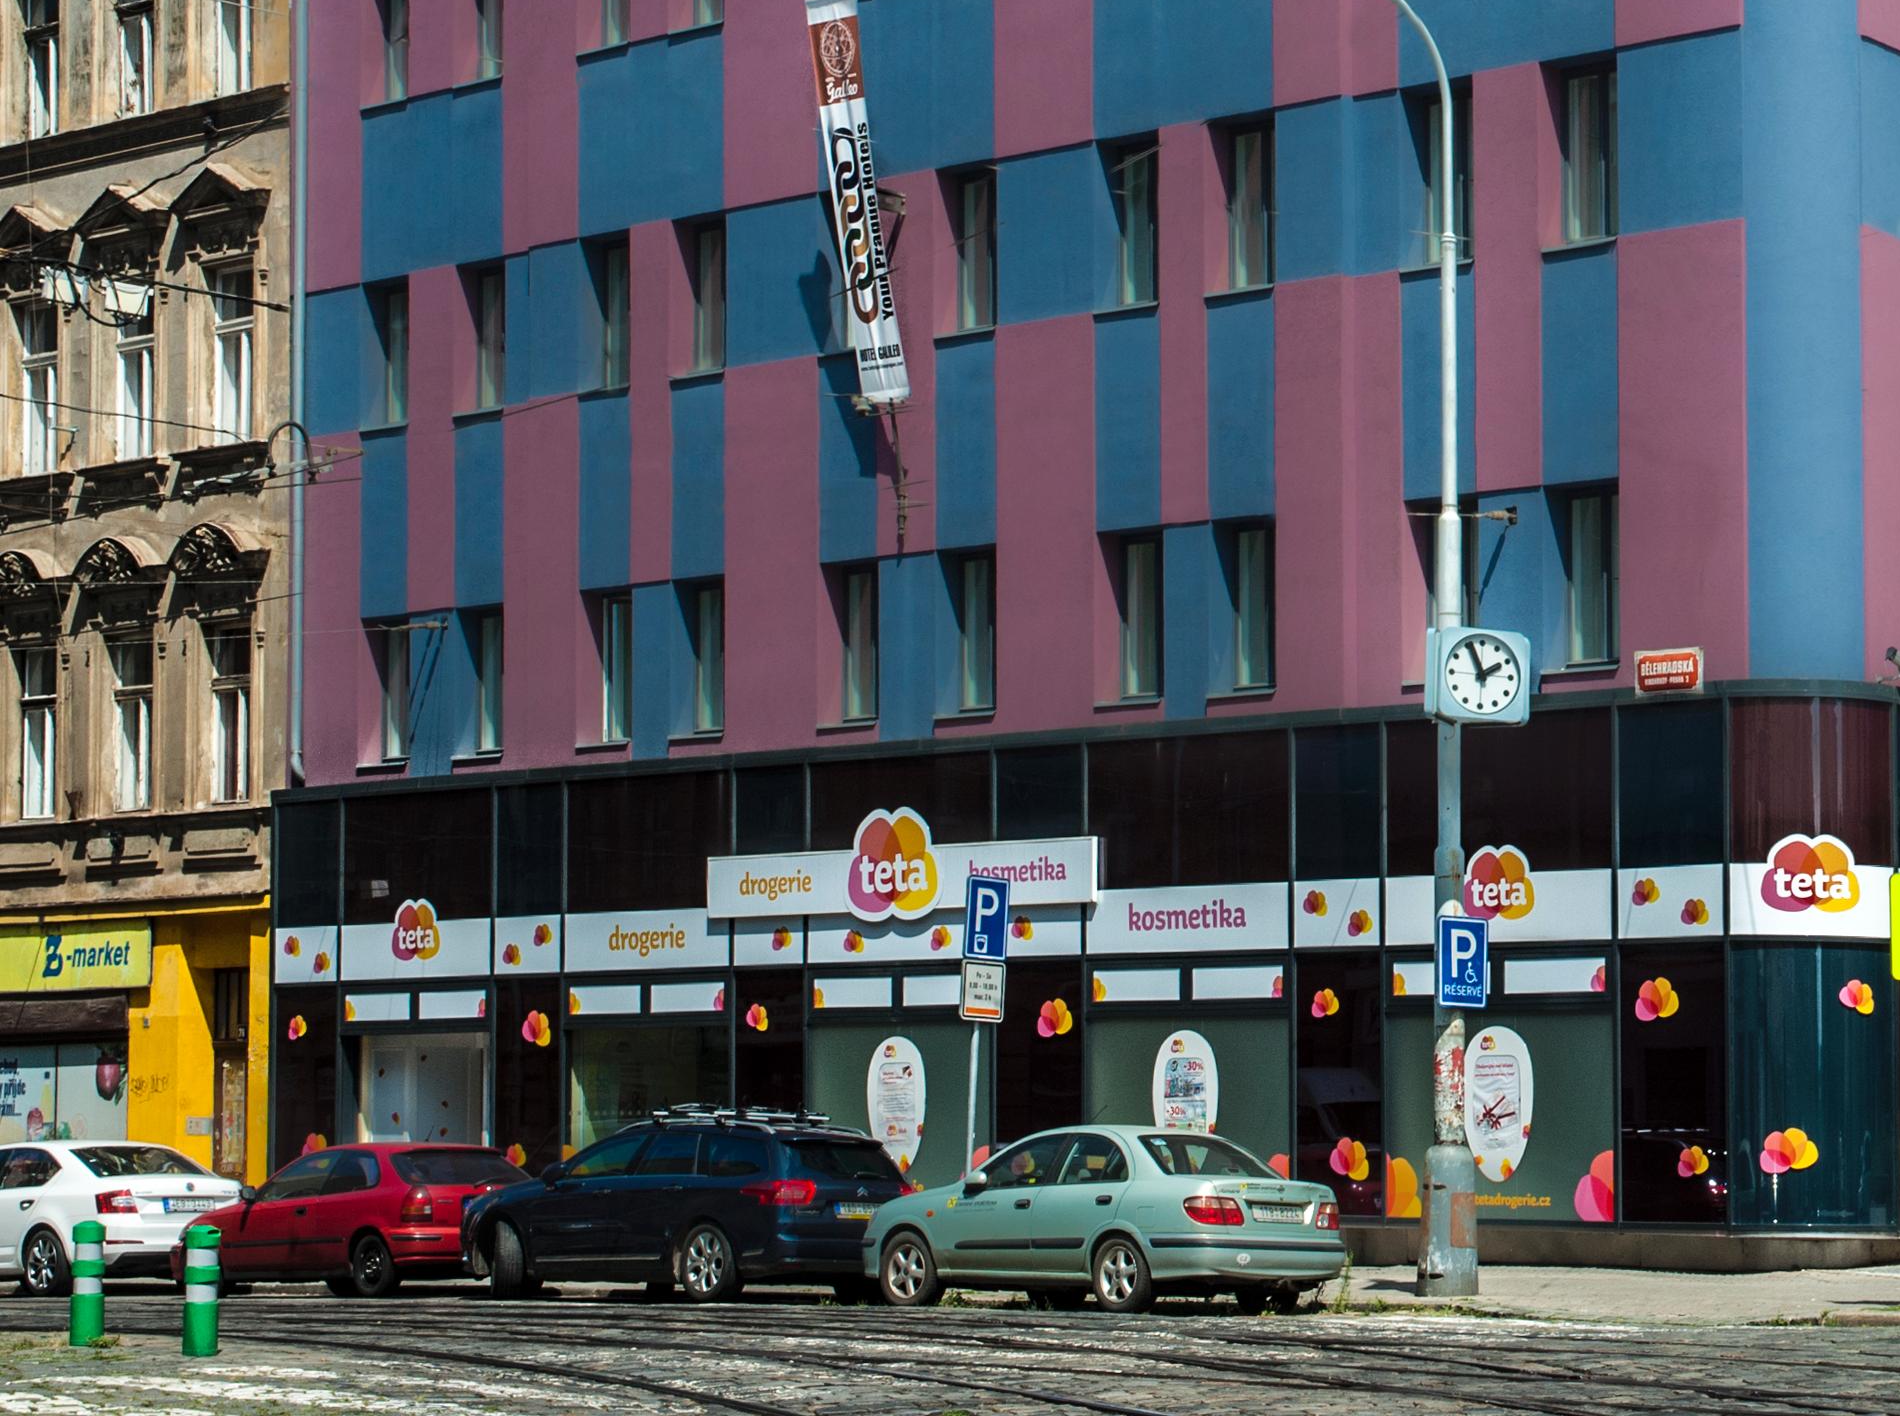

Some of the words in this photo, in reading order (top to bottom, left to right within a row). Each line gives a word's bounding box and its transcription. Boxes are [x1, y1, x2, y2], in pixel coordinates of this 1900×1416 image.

[857, 122, 875, 191] Hotels
[867, 195, 886, 270] Prague
[879, 276, 895, 321] Your
[739, 869, 812, 901] drogerie
[859, 853, 928, 894] teta
[1471, 878, 1527, 907] teta
[1774, 867, 1852, 900] teta
[975, 887, 1000, 933] P
[1128, 898, 1247, 931] kosmetika
[398, 924, 435, 950] teta
[608, 923, 686, 957] drogerie
[1451, 928, 1477, 978] P
[1183, 1061, 1204, 1071] -30%
